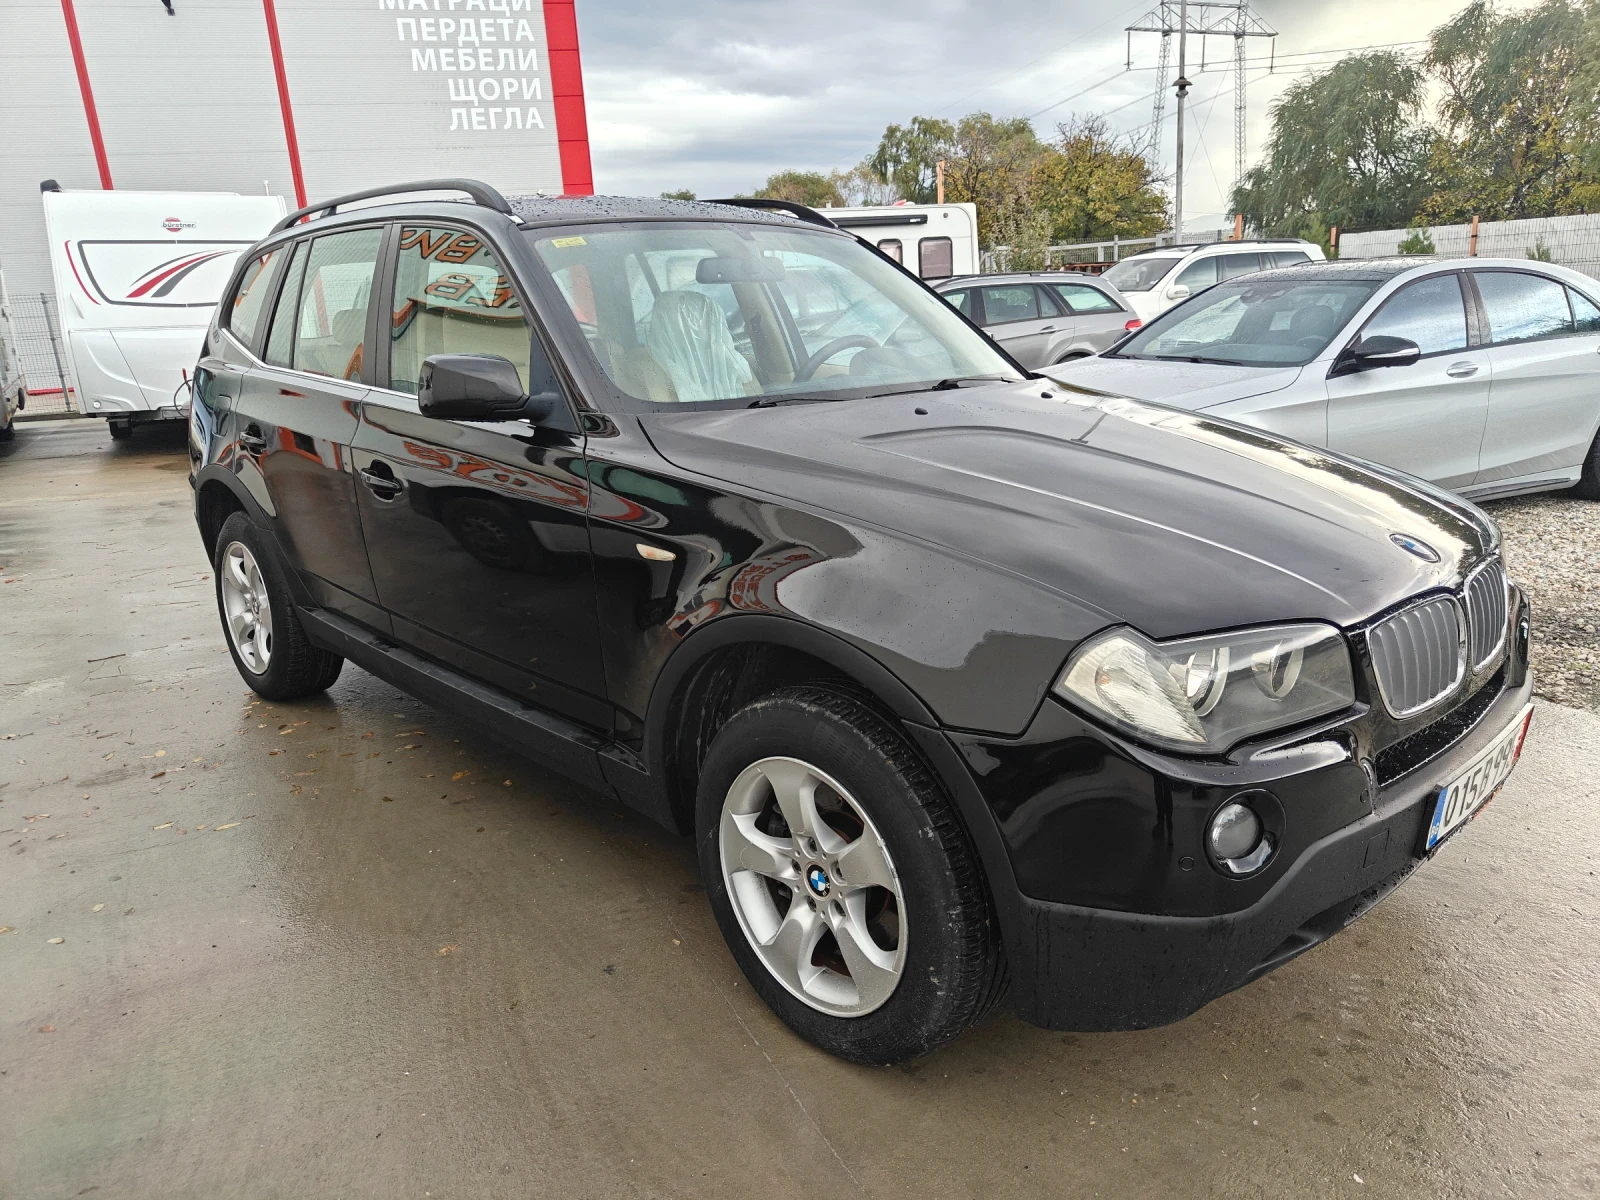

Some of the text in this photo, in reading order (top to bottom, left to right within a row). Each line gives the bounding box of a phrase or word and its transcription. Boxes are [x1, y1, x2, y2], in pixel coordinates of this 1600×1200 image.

[396, 17, 535, 47] ПЕРДЕТА
[411, 48, 538, 72] МЕБЕЛИ
[448, 77, 542, 106] ЩОРИ
[449, 107, 545, 131] ЛЕГЛА
